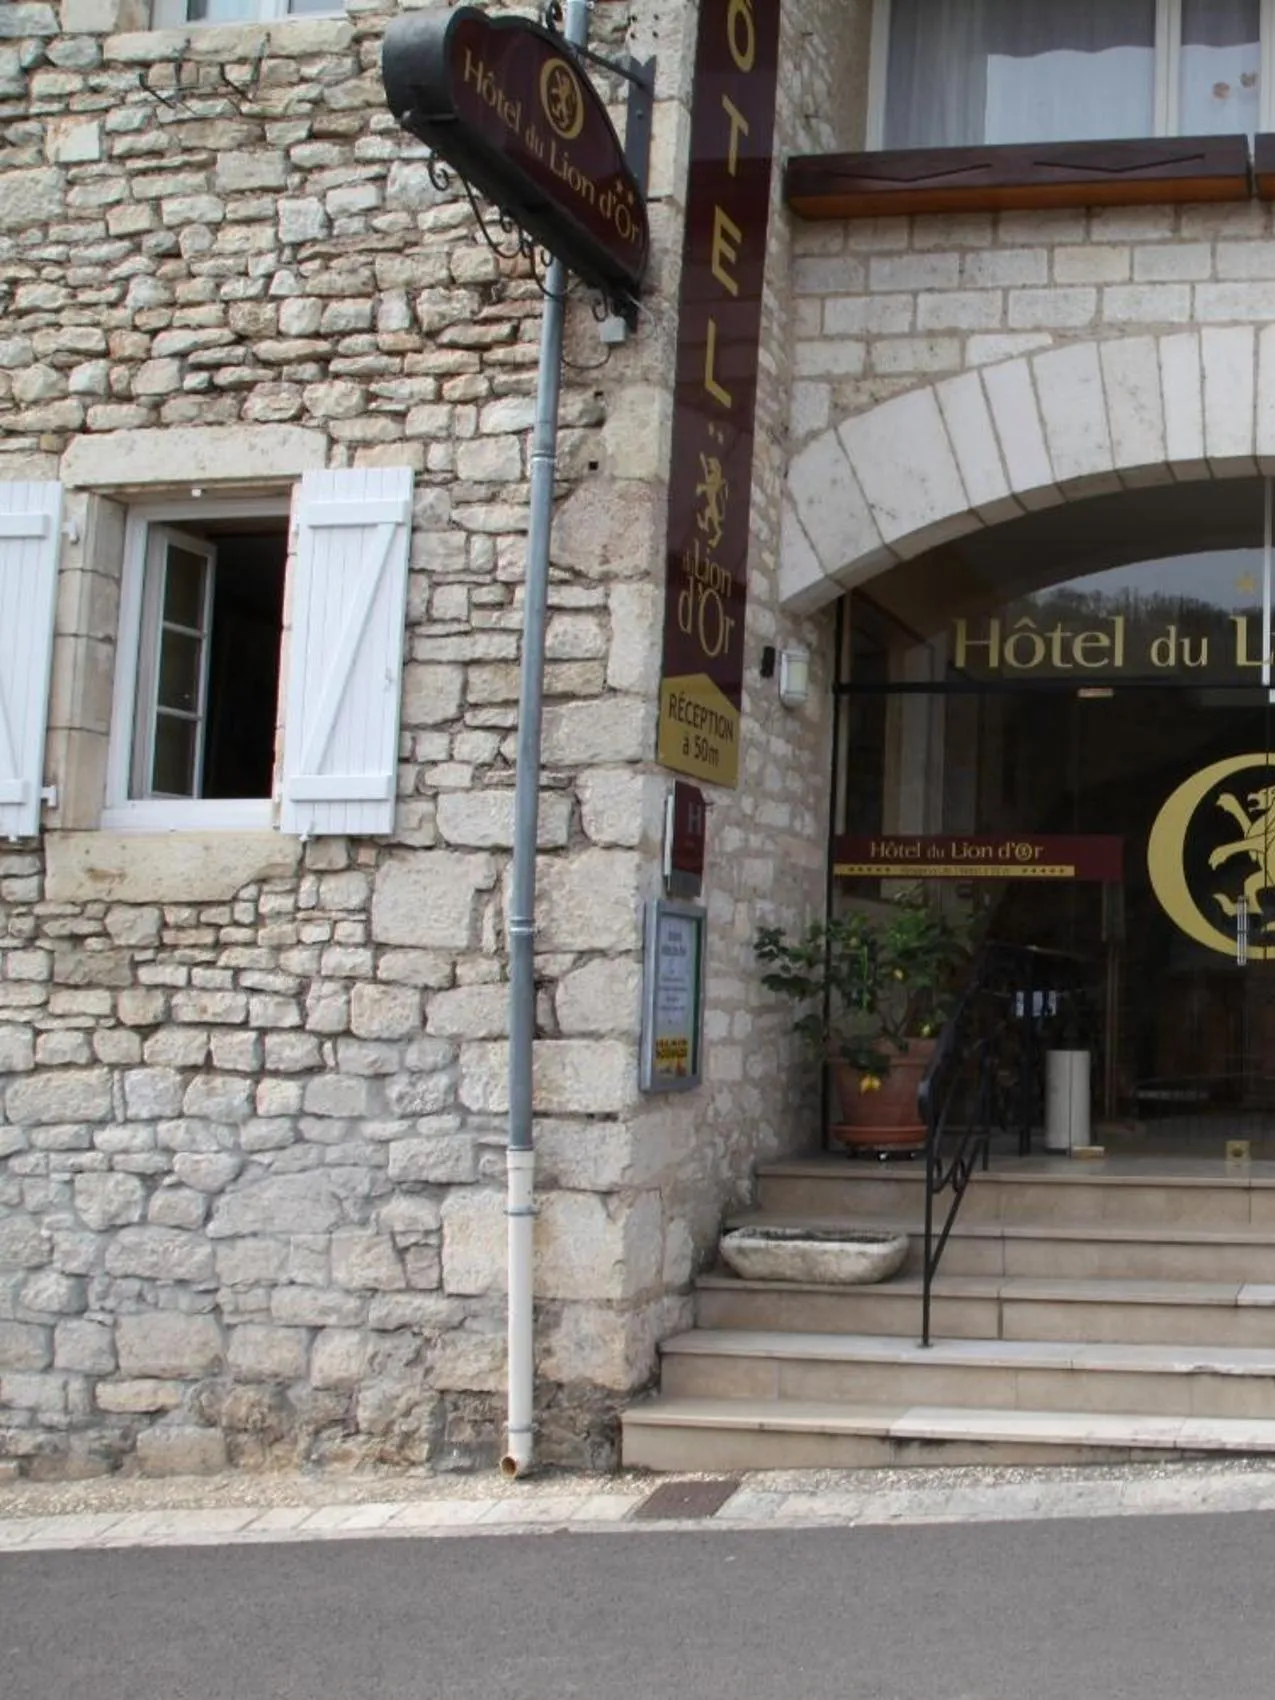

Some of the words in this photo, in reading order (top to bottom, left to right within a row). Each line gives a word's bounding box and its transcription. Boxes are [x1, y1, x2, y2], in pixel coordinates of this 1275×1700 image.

[463, 47, 522, 133] Hôtel
[524, 123, 544, 158] du
[550, 139, 595, 205] Lion
[600, 188, 640, 242] d'Or
[694, 537, 732, 598] Lion
[678, 575, 736, 658] d'Or
[953, 615, 1124, 669] Hôtel
[1150, 624, 1209, 668] du
[668, 691, 735, 744] RÉCEPTION
[682, 732, 690, 757] à
[694, 734, 720, 768] 50m
[870, 841, 921, 859] Hôtel
[928, 845, 945, 859] du
[951, 841, 993, 859] Lion
